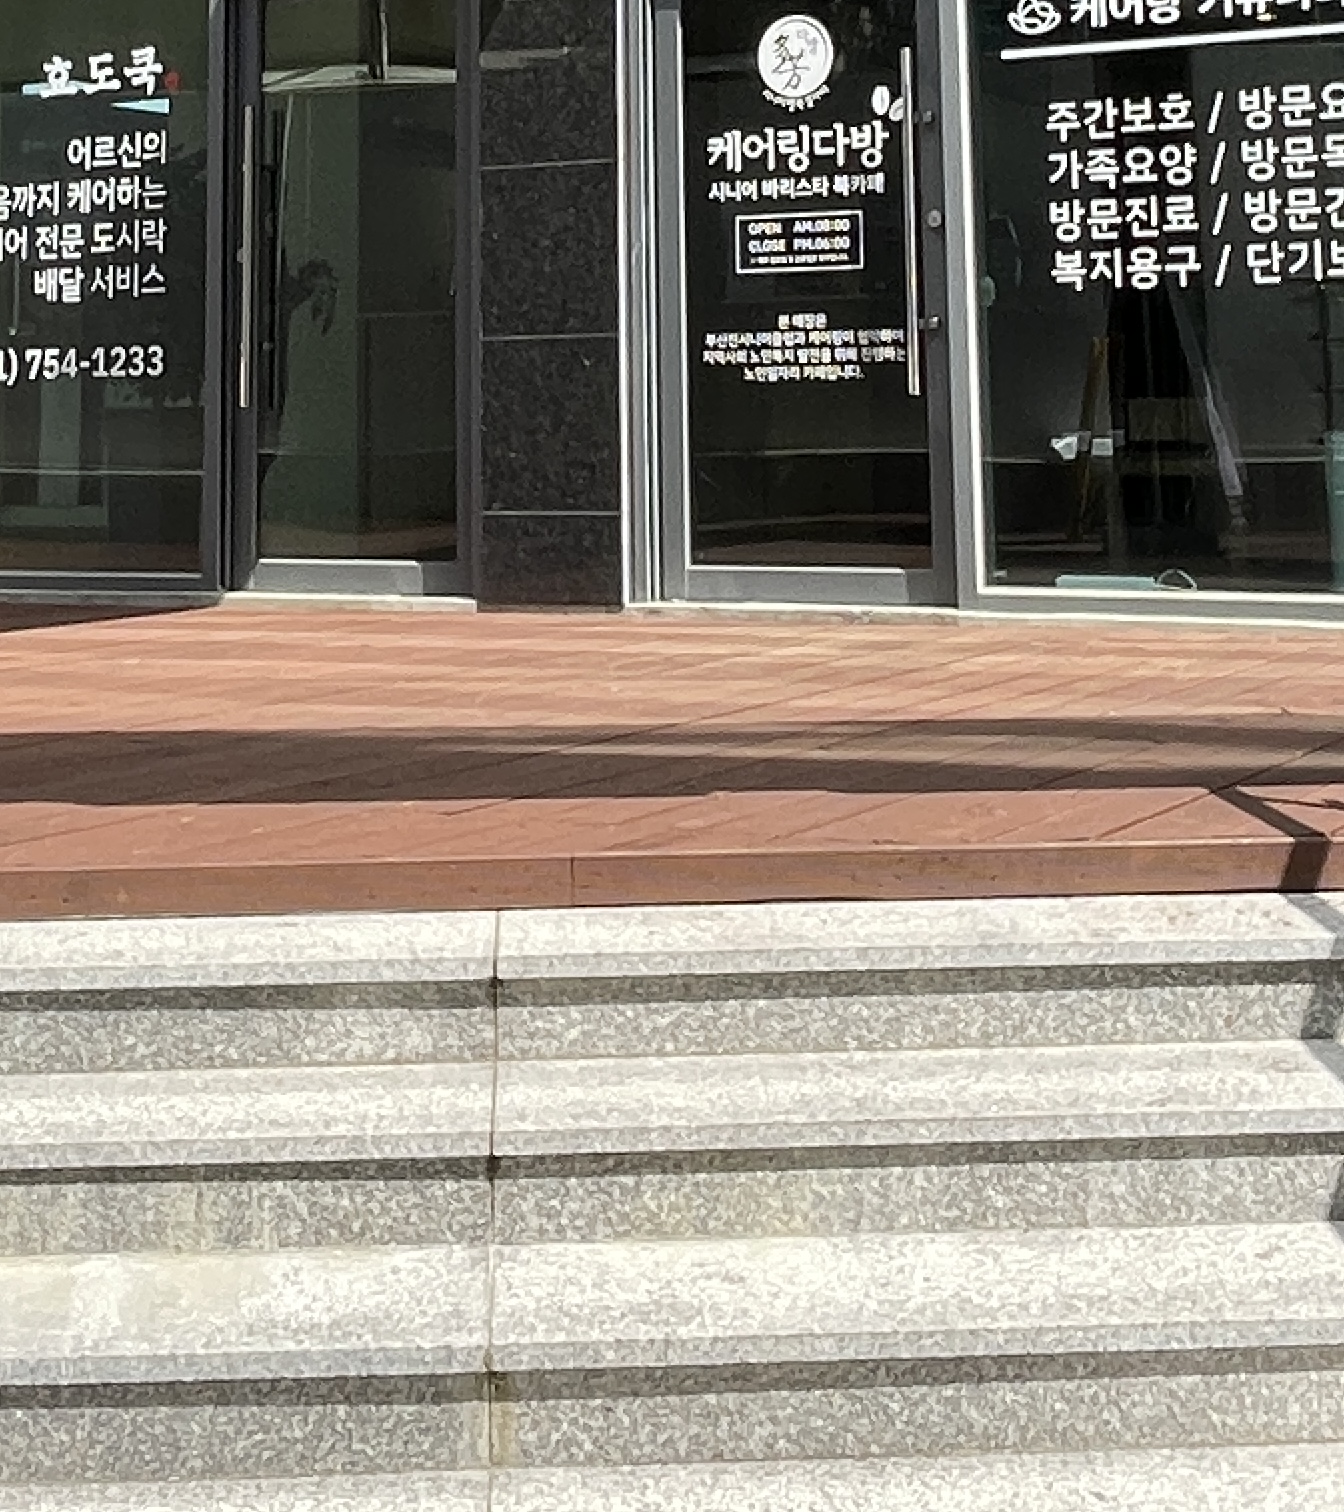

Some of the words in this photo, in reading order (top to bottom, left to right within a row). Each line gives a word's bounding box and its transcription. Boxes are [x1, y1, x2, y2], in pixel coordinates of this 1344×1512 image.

[1045, 93, 1197, 142] 주간보호
[1207, 90, 1224, 134] /
[67, 130, 166, 169] 어르신의
[706, 120, 890, 173] 케어링다방
[1047, 142, 1199, 190] 가족요양
[1210, 141, 1226, 185] /
[66, 176, 166, 214] 케어하는
[708, 178, 758, 203] 시니어
[760, 174, 830, 200] 바리스타
[747, 222, 783, 236] OPEN
[1049, 195, 1200, 243] 방문진료
[1212, 192, 1228, 235] /
[34, 222, 84, 261] 전문
[90, 219, 166, 256] 도시락
[747, 238, 786, 254] CLOSE
[34, 267, 83, 302] 배달
[89, 264, 166, 298] 서비스
[1050, 244, 1202, 291] 복지용구
[1214, 244, 1231, 287] /
[25, 344, 164, 382] 754-1233
